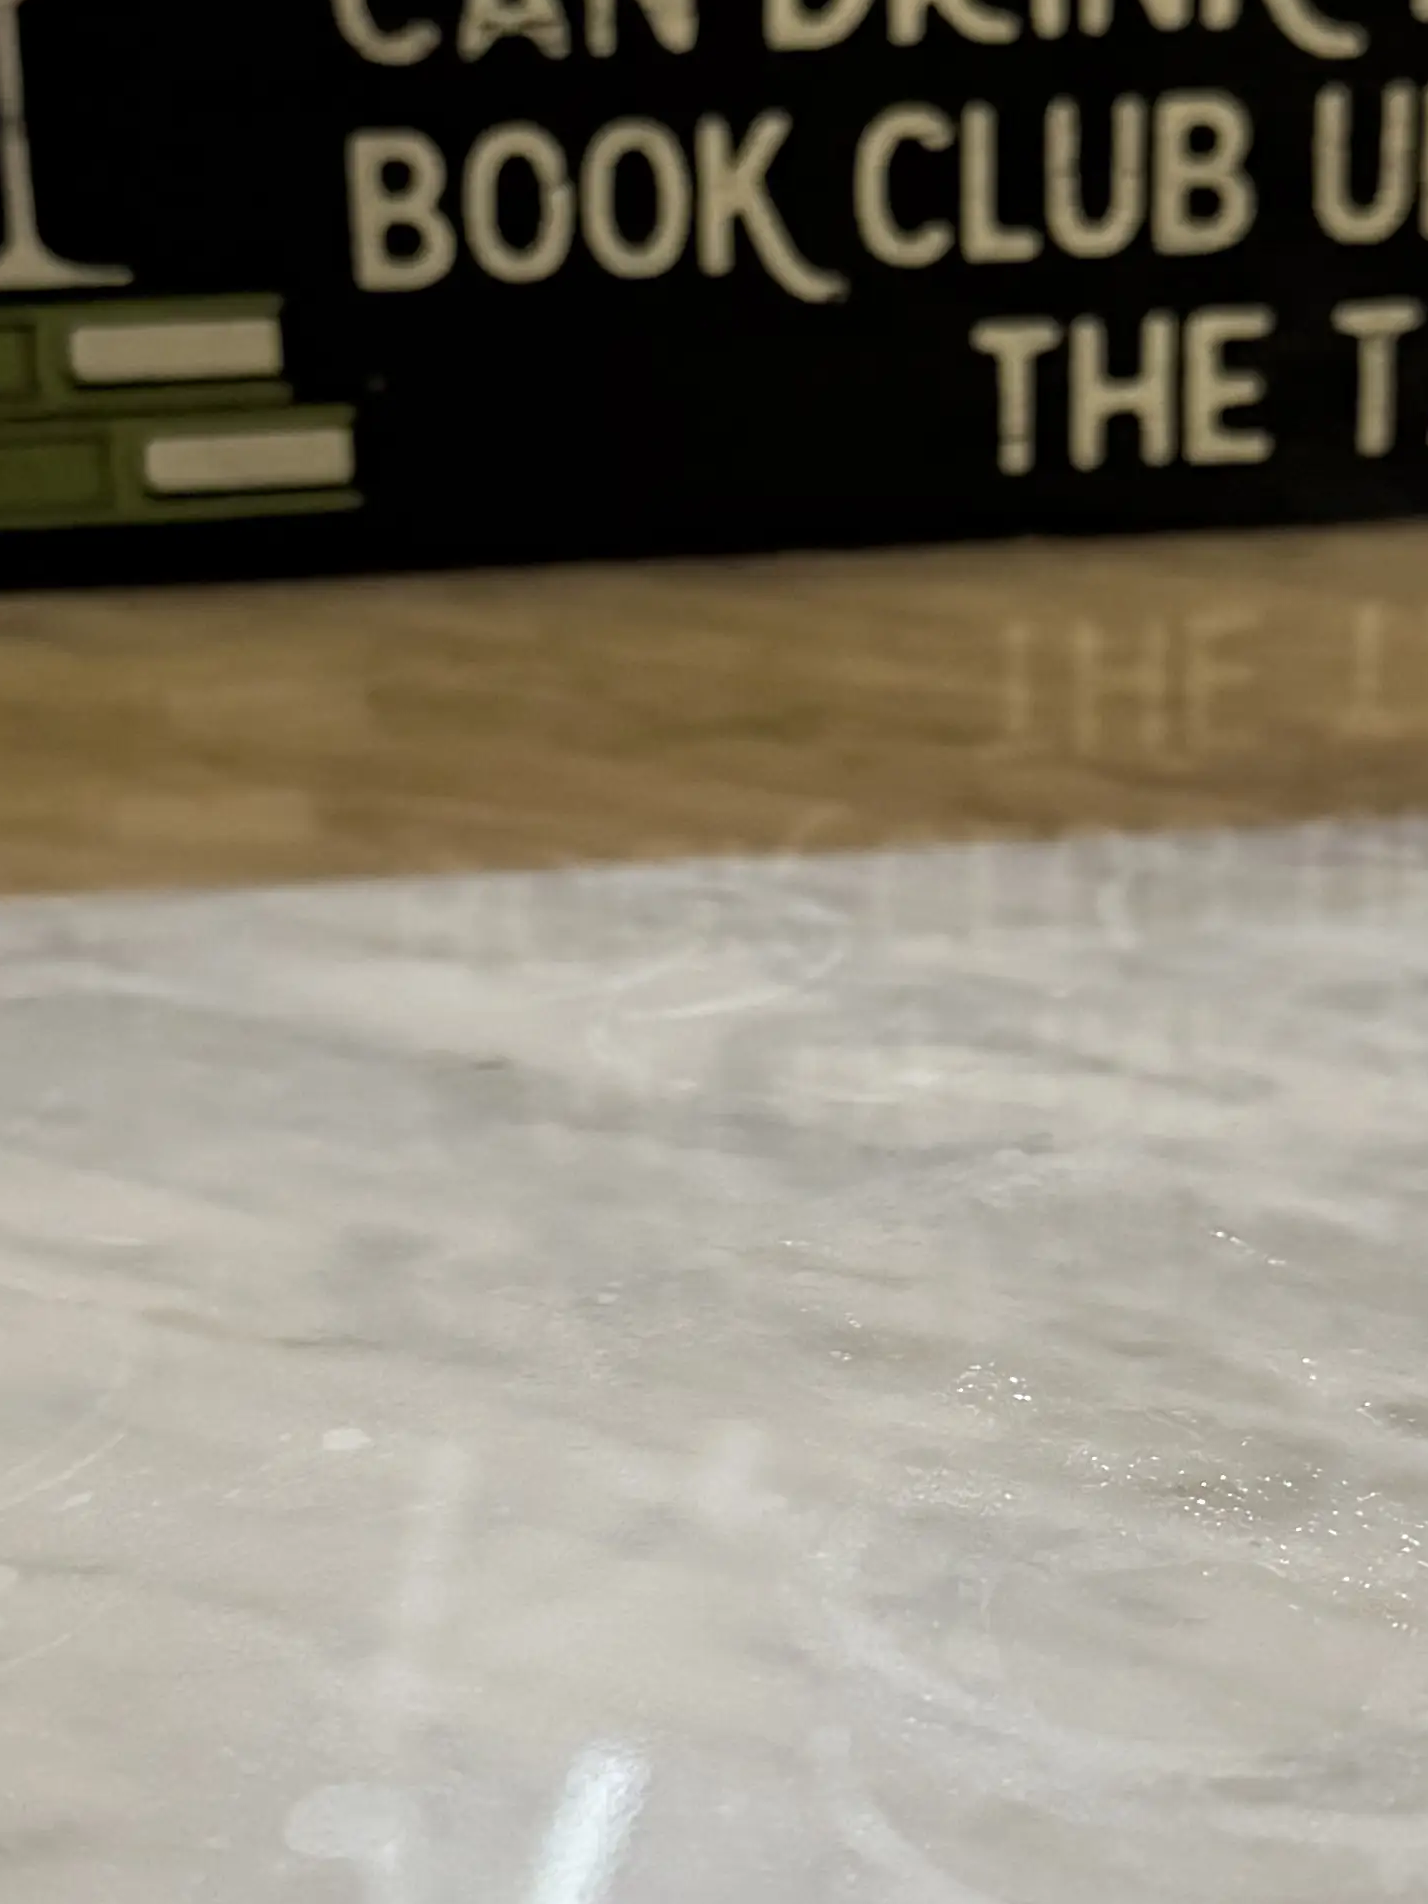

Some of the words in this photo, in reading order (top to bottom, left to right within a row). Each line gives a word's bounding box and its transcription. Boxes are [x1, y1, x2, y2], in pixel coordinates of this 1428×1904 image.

[348, 112, 845, 302] BOOK
[855, 92, 1255, 267] CLUB
[972, 308, 1272, 474] THE
